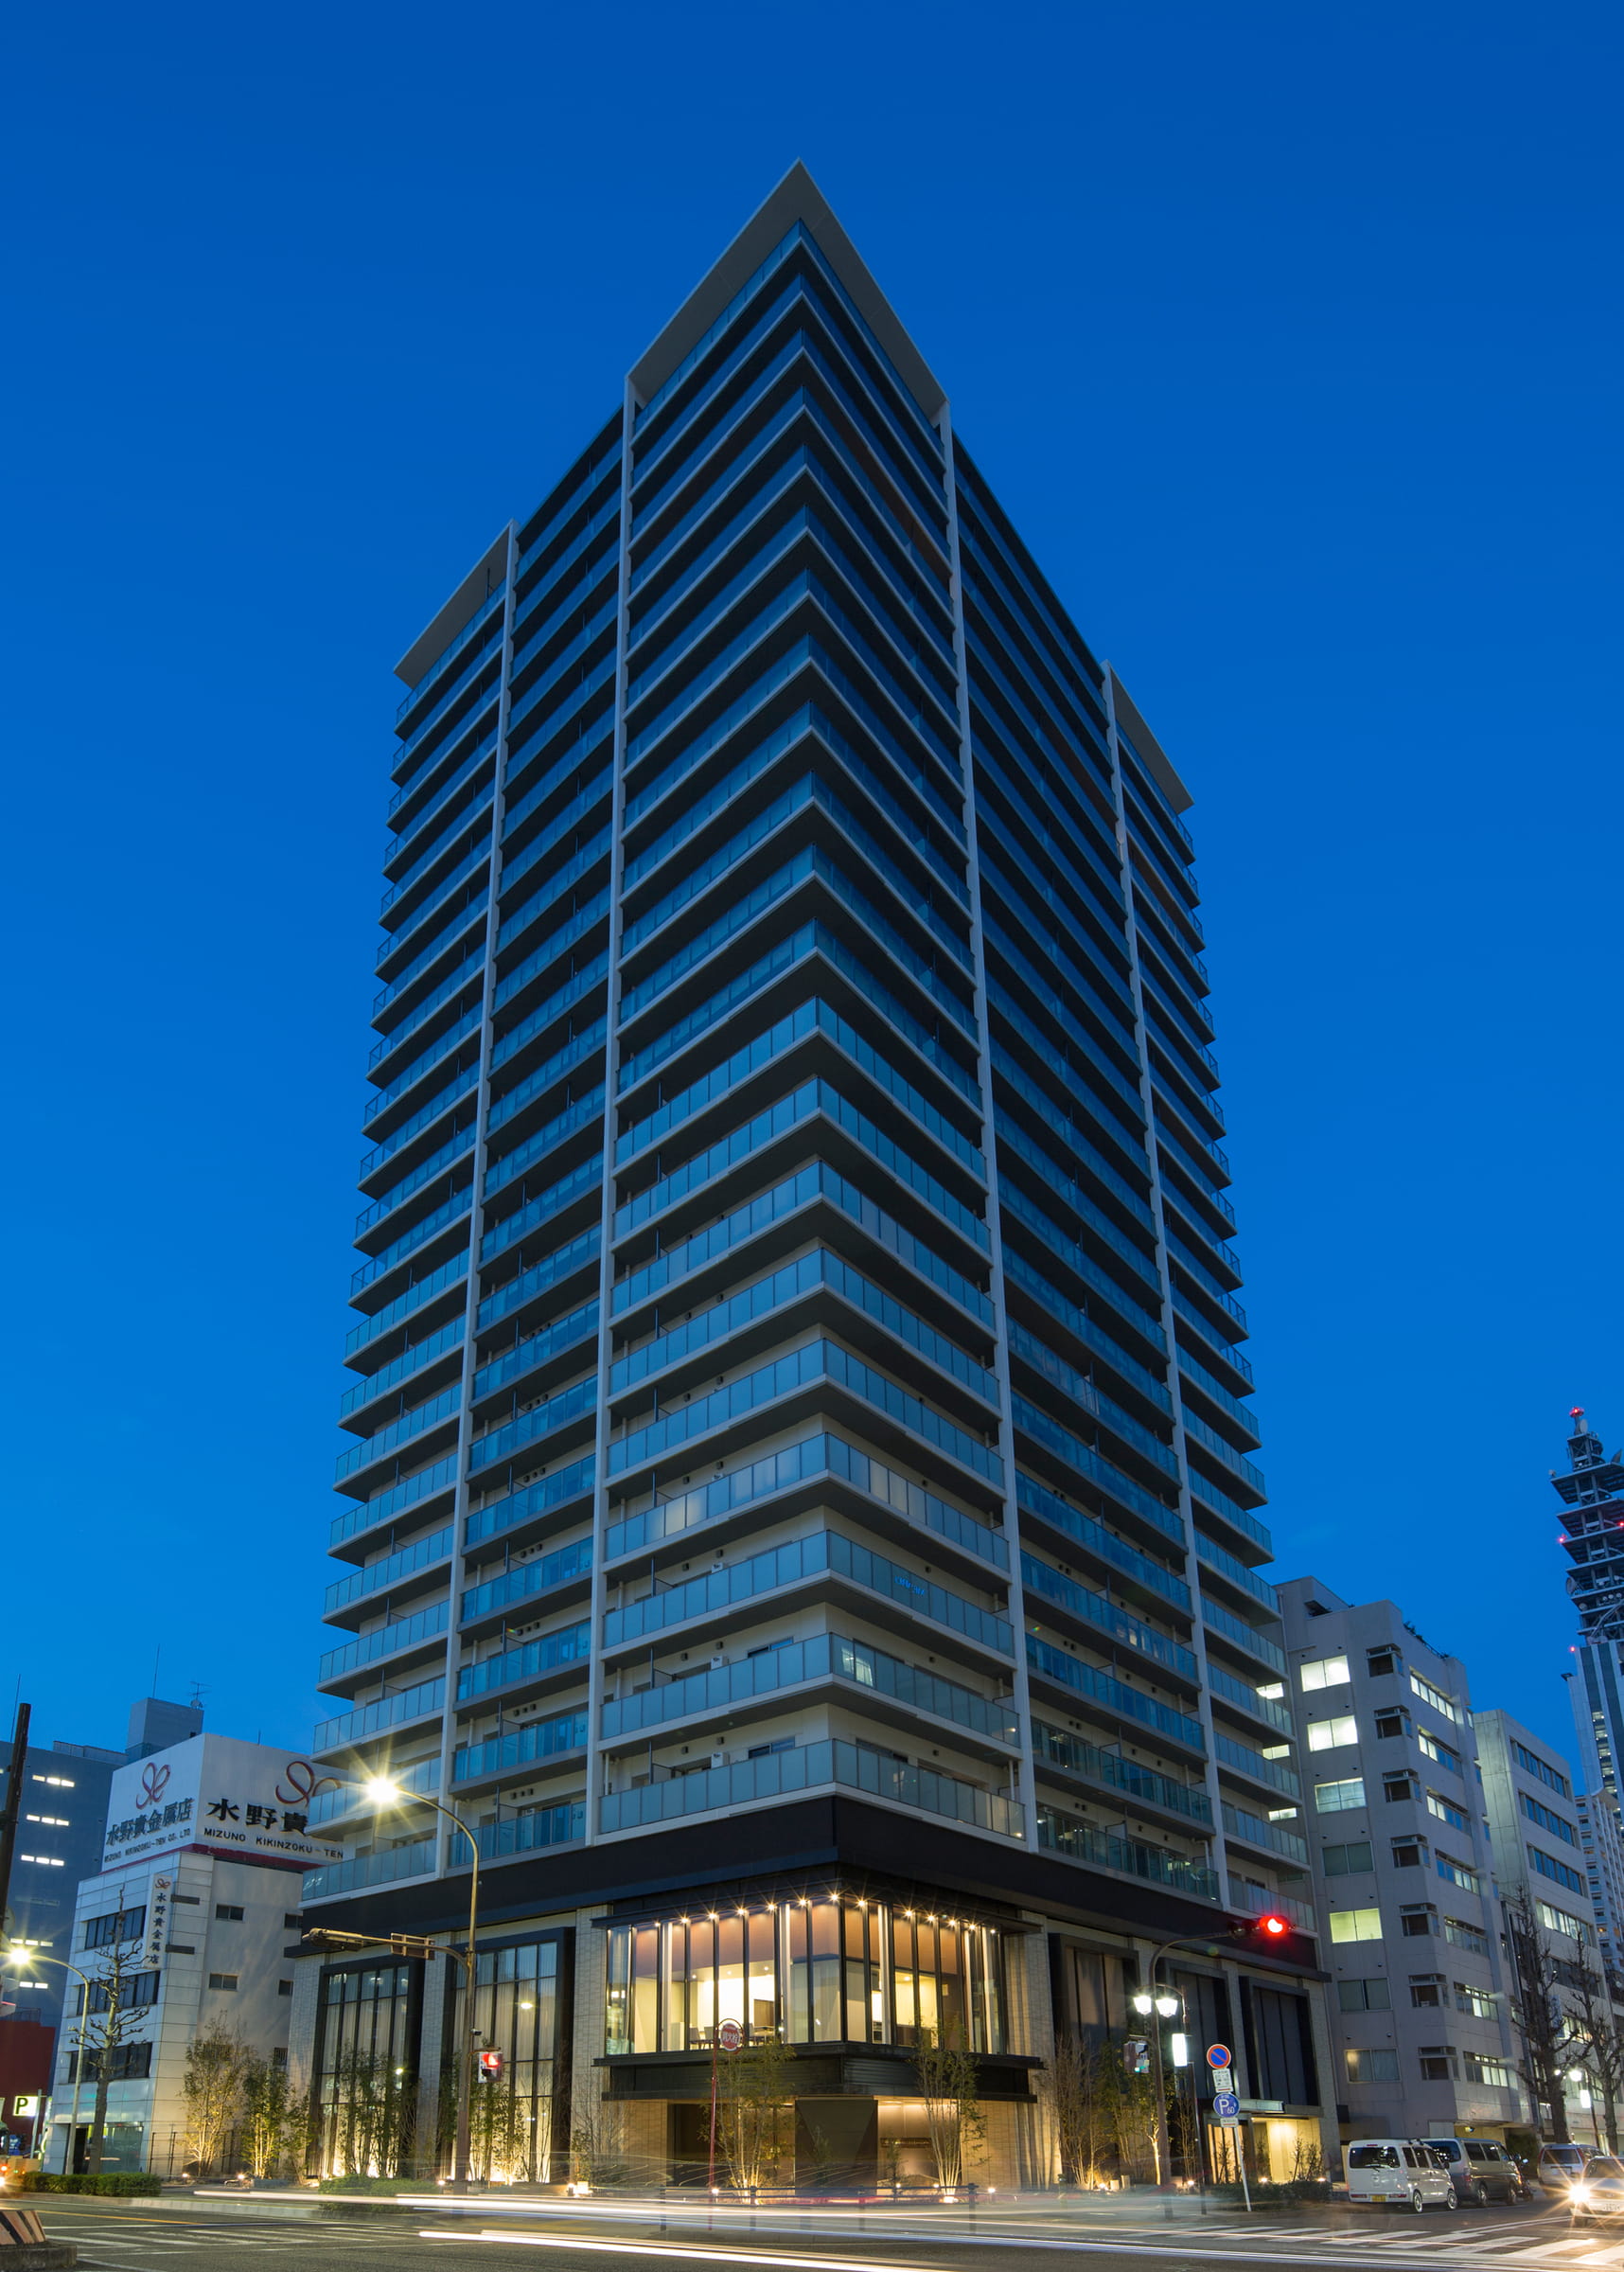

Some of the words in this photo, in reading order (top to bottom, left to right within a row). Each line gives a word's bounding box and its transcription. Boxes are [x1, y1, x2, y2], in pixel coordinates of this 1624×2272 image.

[203, 1827, 246, 1842] MIZUNO
[15, 2097, 28, 2114] P
[1219, 2099, 1229, 2114] P
